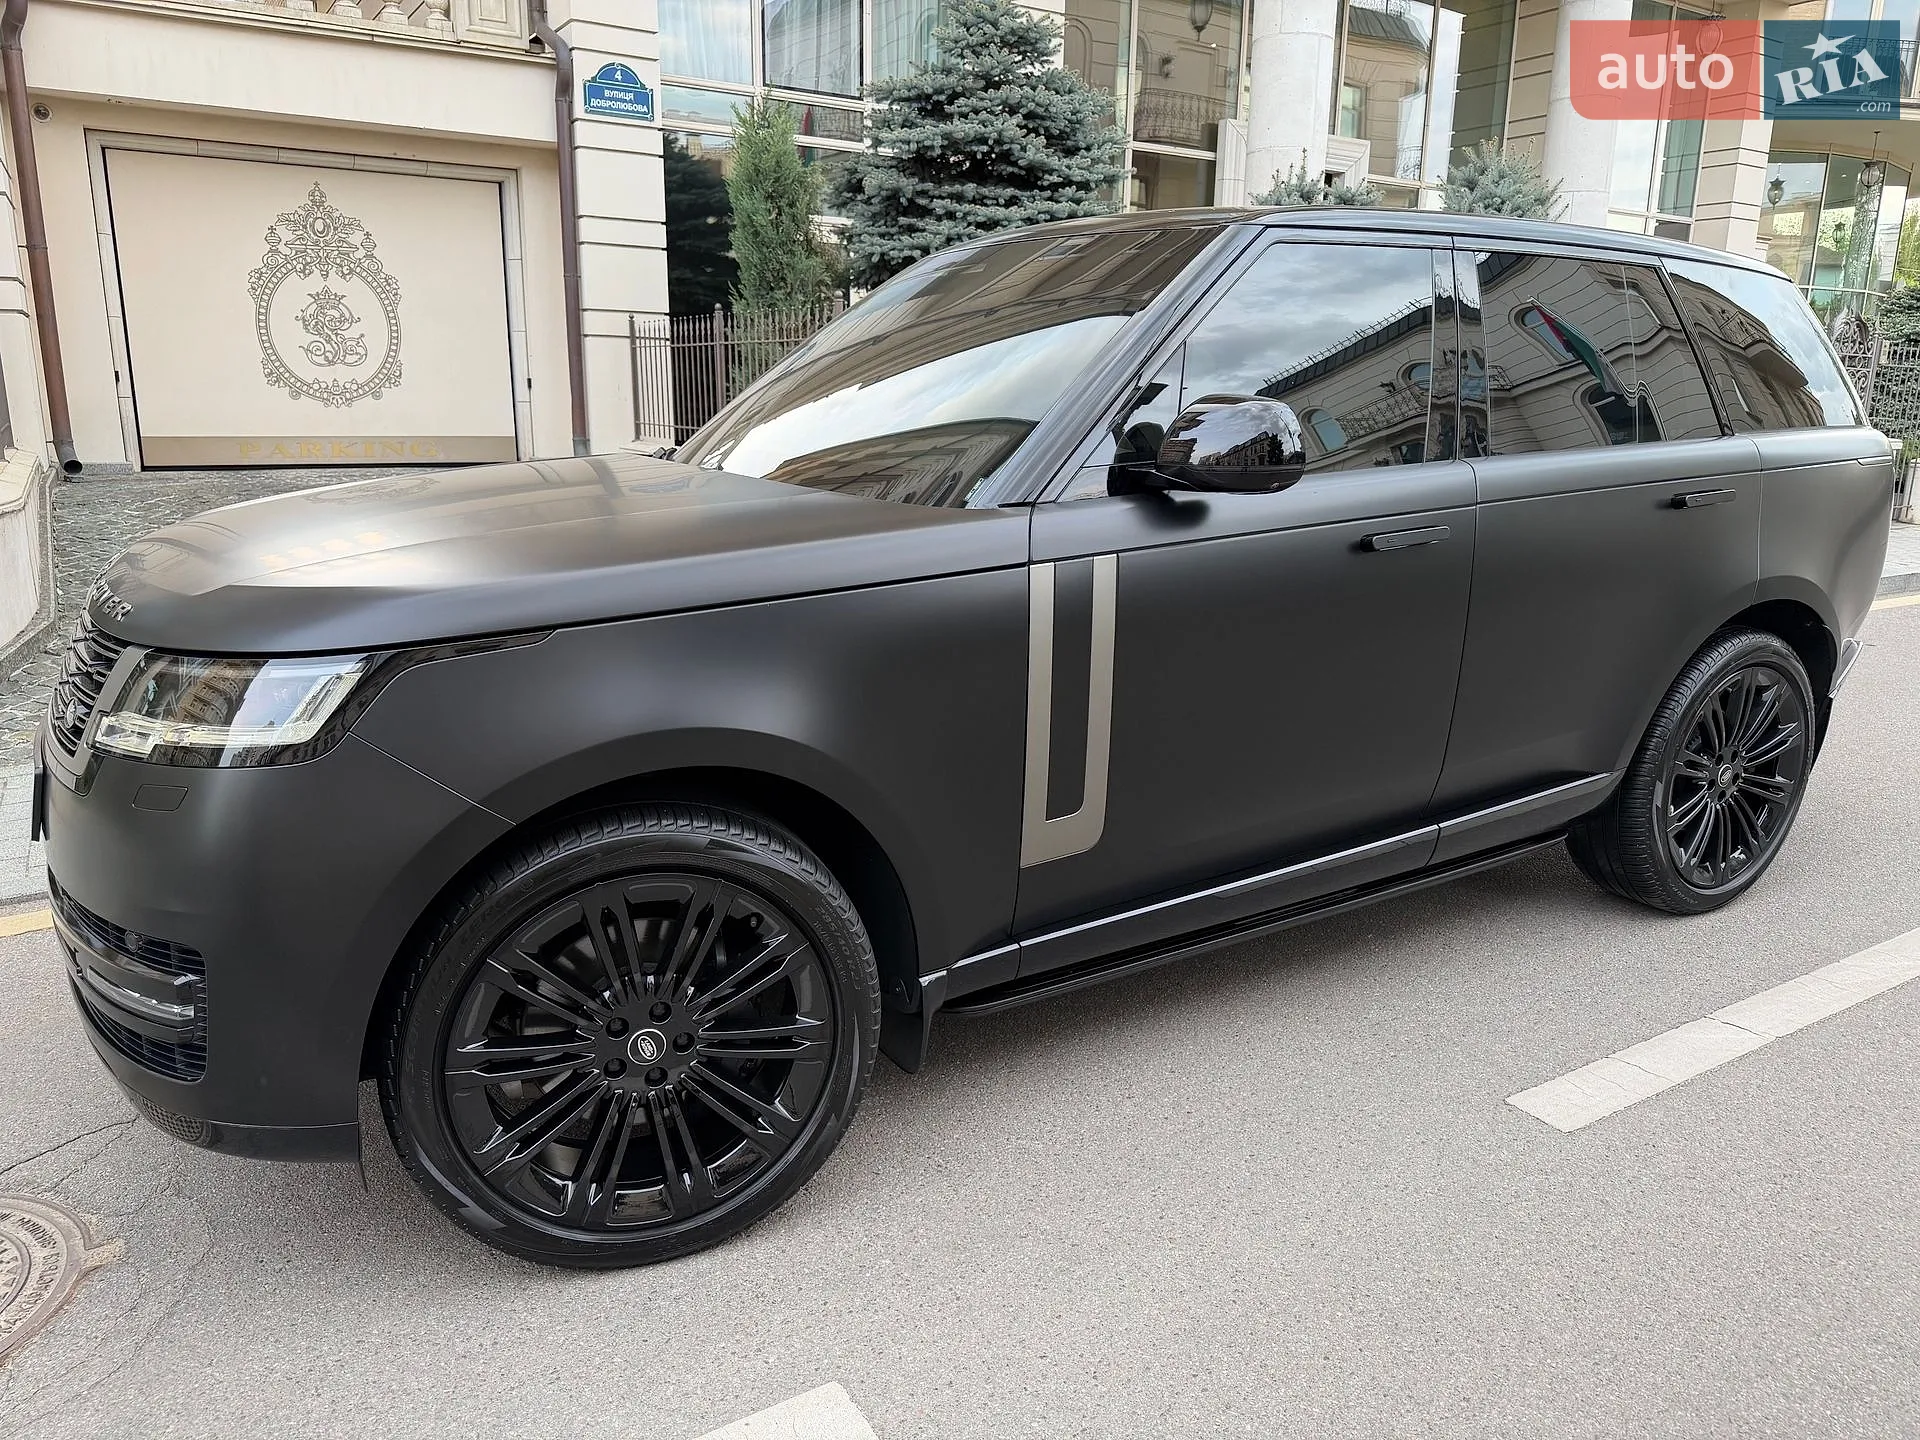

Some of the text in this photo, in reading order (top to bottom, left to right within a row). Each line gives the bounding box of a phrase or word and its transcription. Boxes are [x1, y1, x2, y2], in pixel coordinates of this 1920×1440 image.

[614, 69, 623, 81] 4
[604, 89, 634, 101] ВУЛИЦЯ
[590, 98, 648, 113] ДОБРОЛЮБОВА
[236, 439, 442, 460] PARKING
